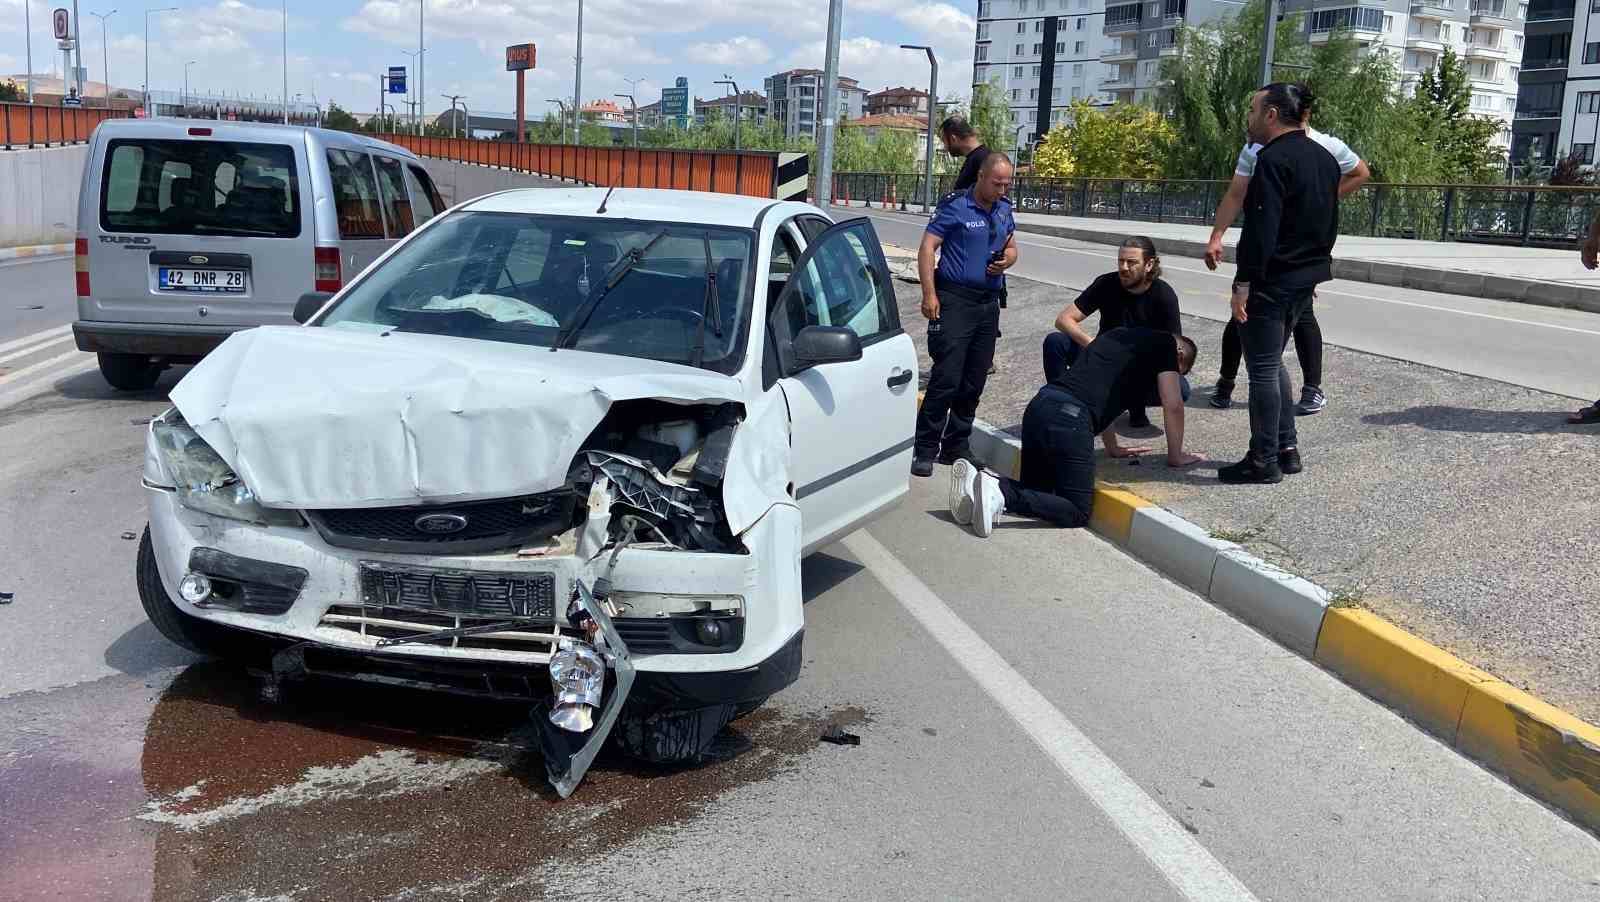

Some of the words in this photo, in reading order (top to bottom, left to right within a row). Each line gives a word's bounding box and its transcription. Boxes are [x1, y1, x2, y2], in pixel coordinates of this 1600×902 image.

[168, 271, 184, 285] 42
[193, 271, 217, 286] DNR
[226, 272, 242, 287] 28
